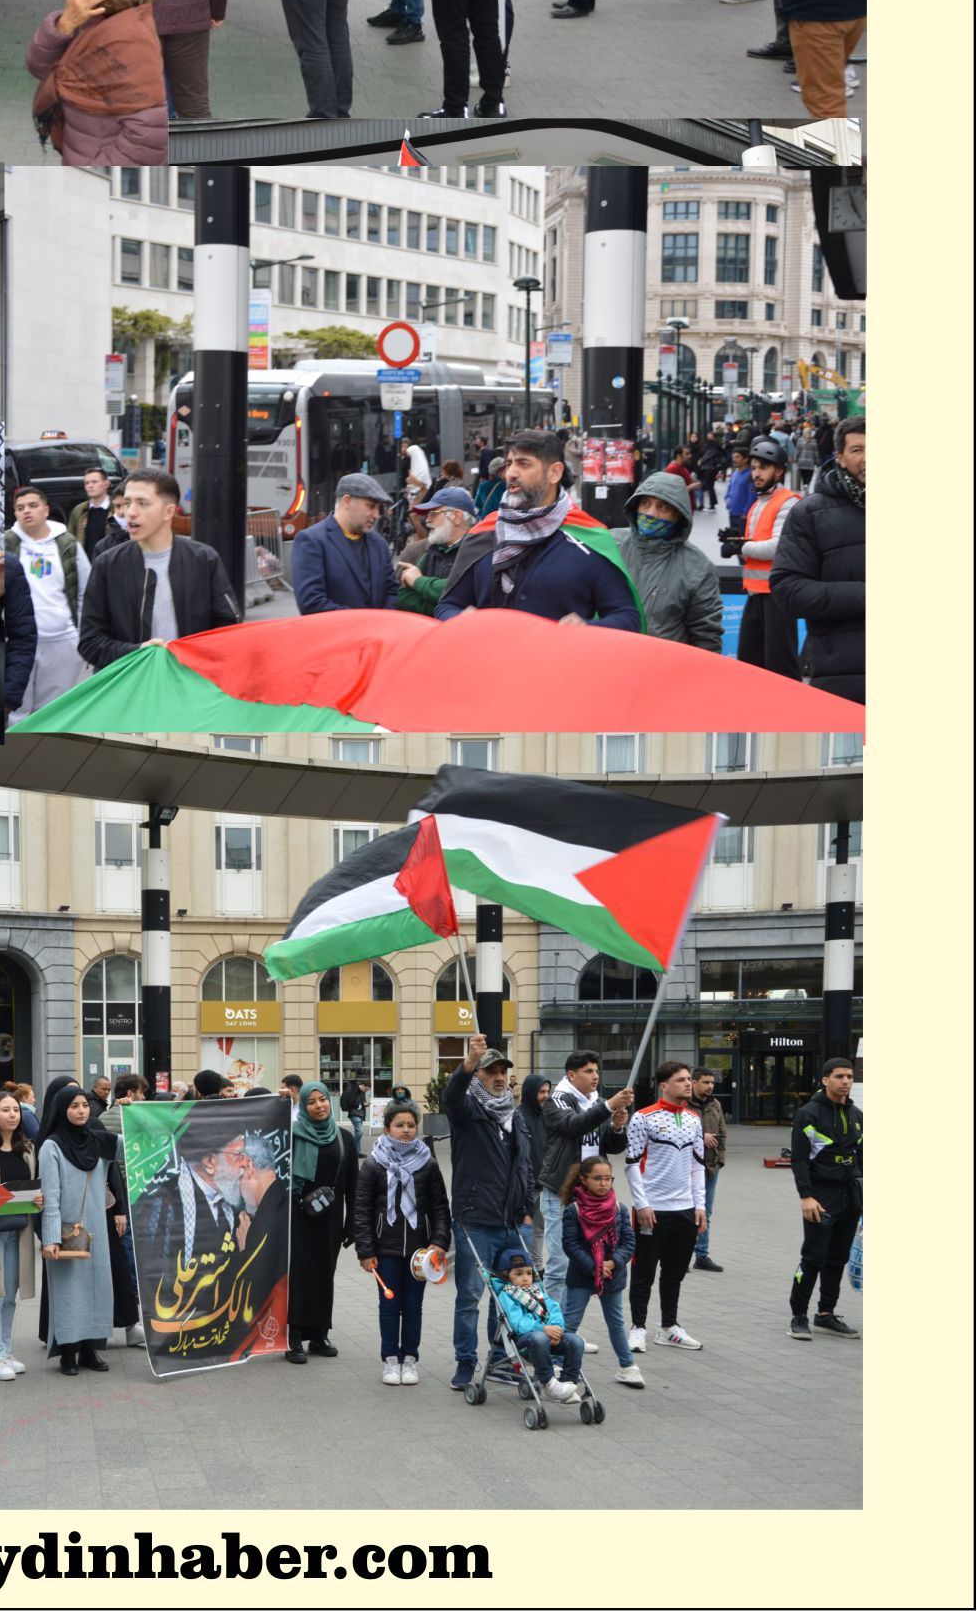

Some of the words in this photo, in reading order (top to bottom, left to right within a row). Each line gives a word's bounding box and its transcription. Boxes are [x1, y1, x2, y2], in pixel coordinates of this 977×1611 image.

[225, 1007, 257, 1020] OATS
[770, 1037, 804, 1047] Hilton
[311, 1194, 330, 1213] 81
